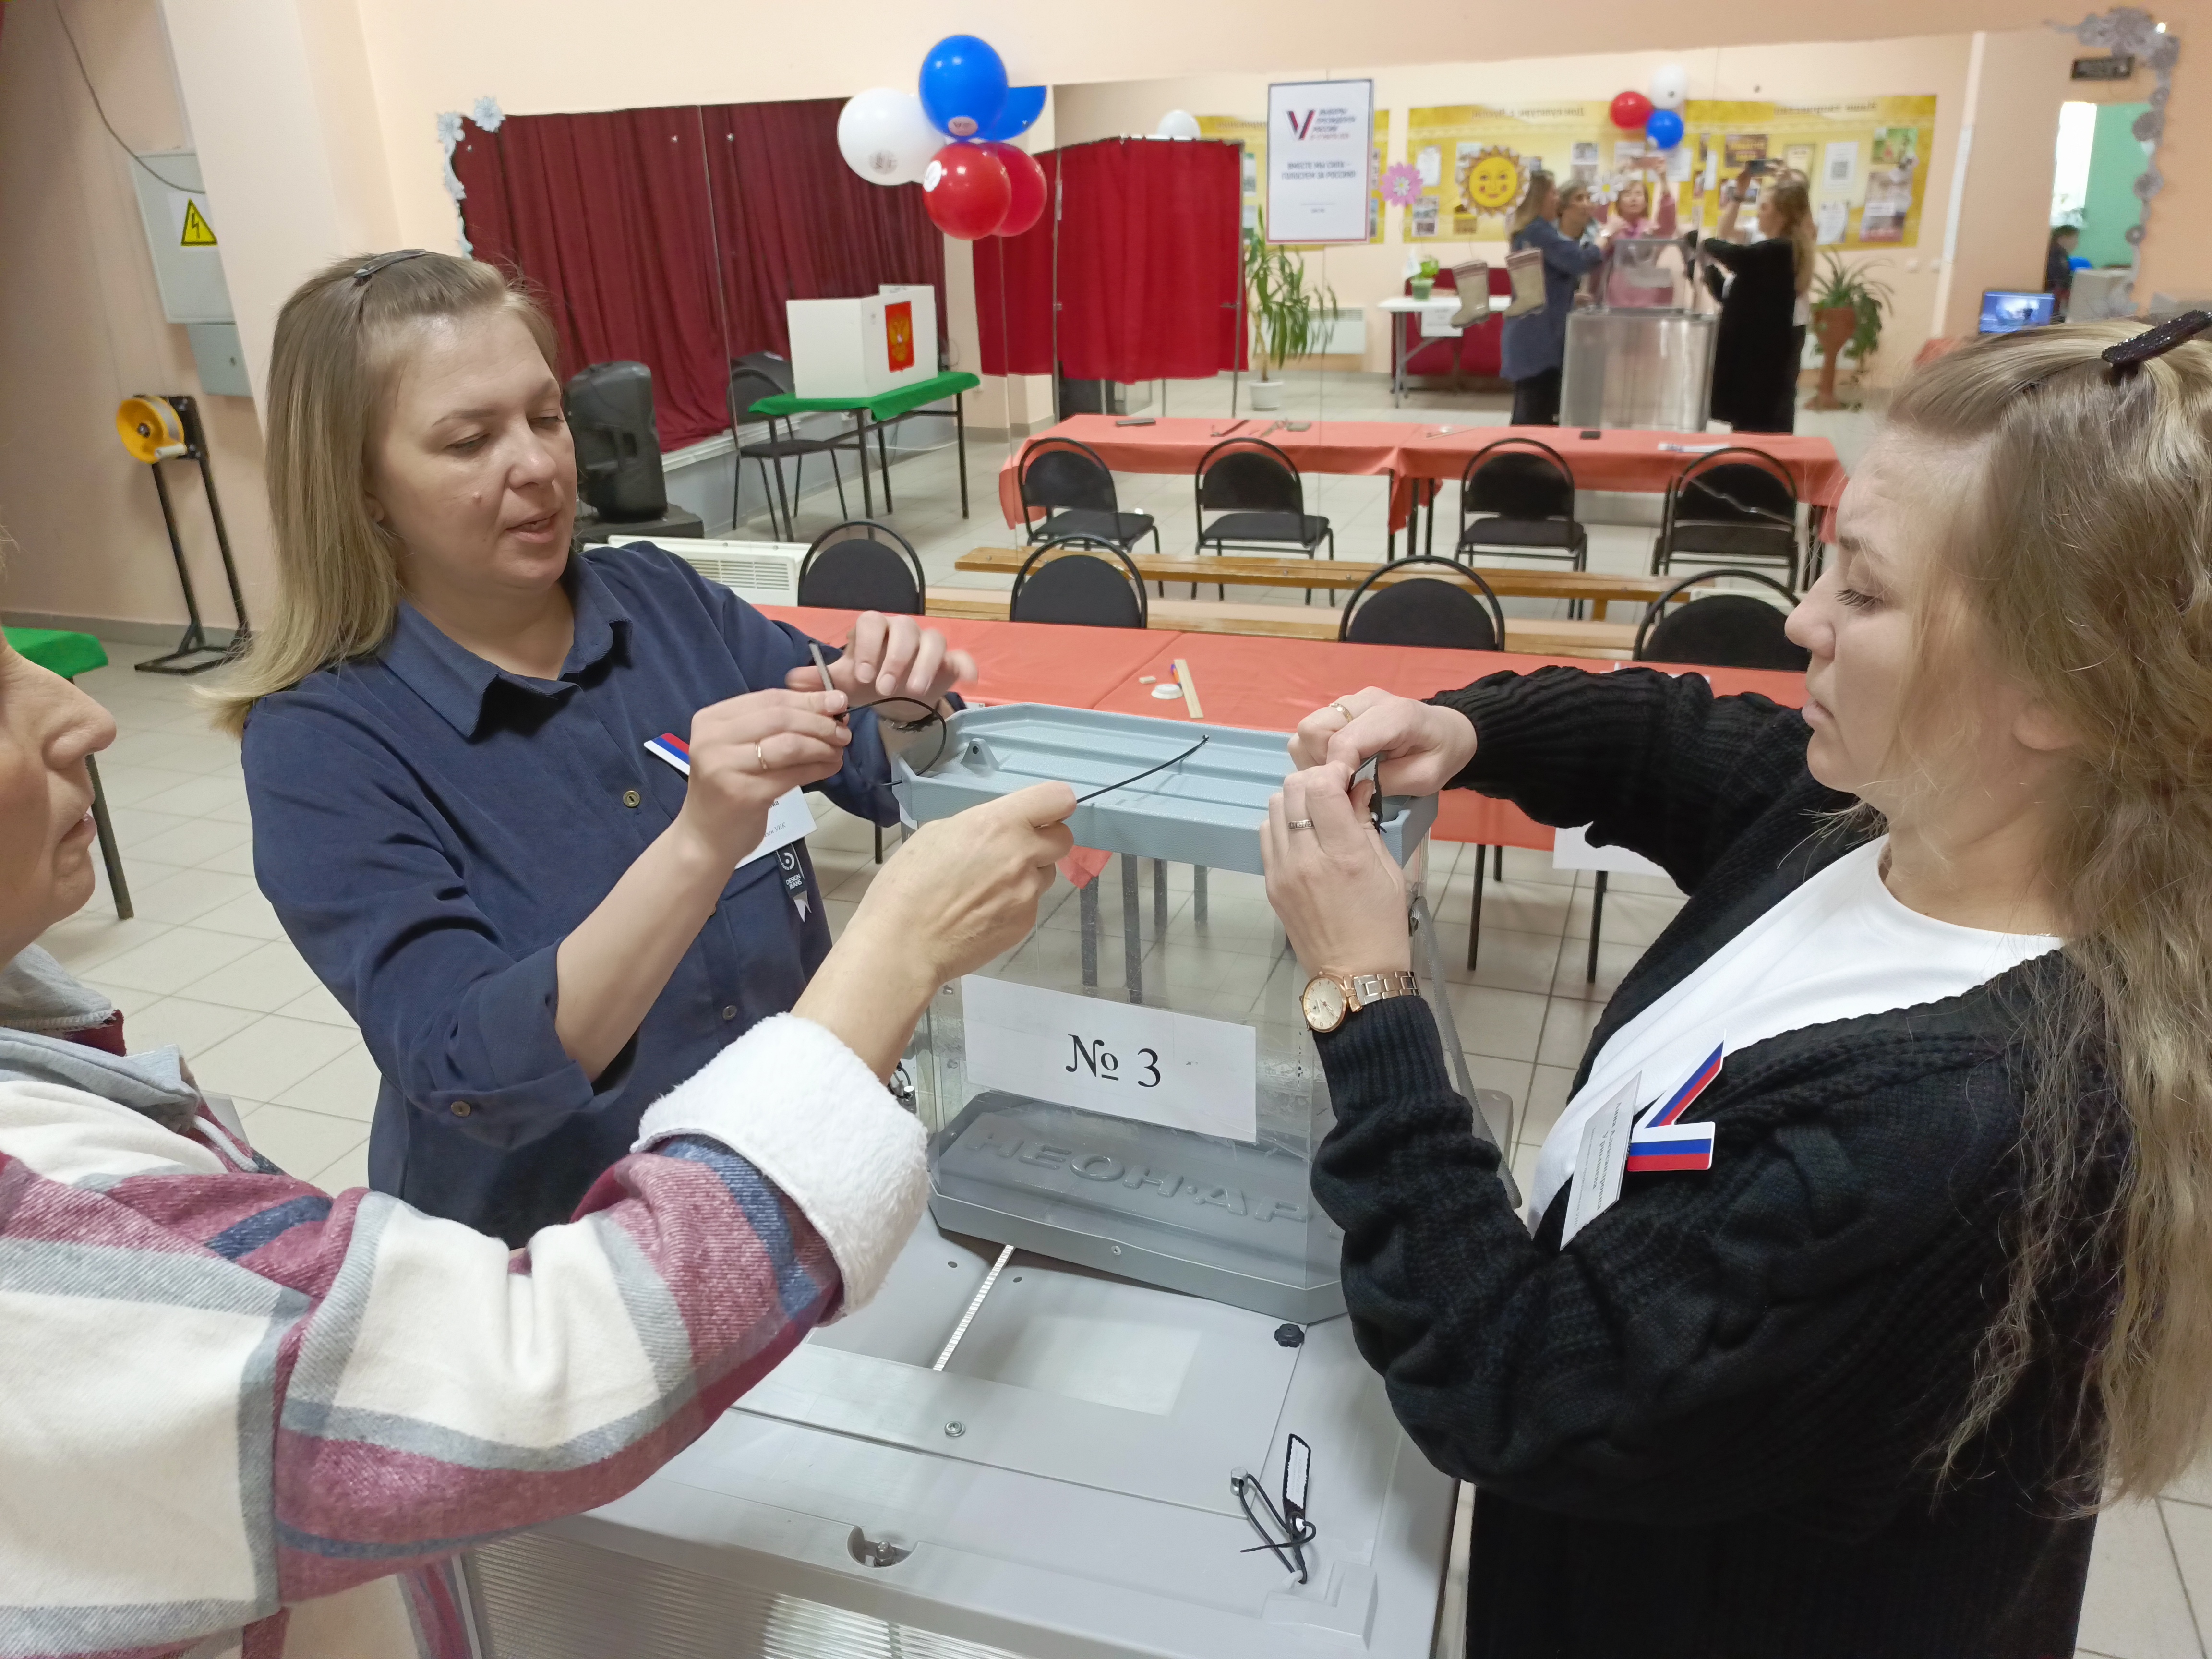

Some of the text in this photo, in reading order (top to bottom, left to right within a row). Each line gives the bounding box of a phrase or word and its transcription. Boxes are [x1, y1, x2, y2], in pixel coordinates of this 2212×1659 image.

[774, 822, 786, 832] УИК
[786, 874, 801, 885] DESIGN
[789, 879, 802, 890] JEANS
[1138, 1048, 1161, 1087] 3
